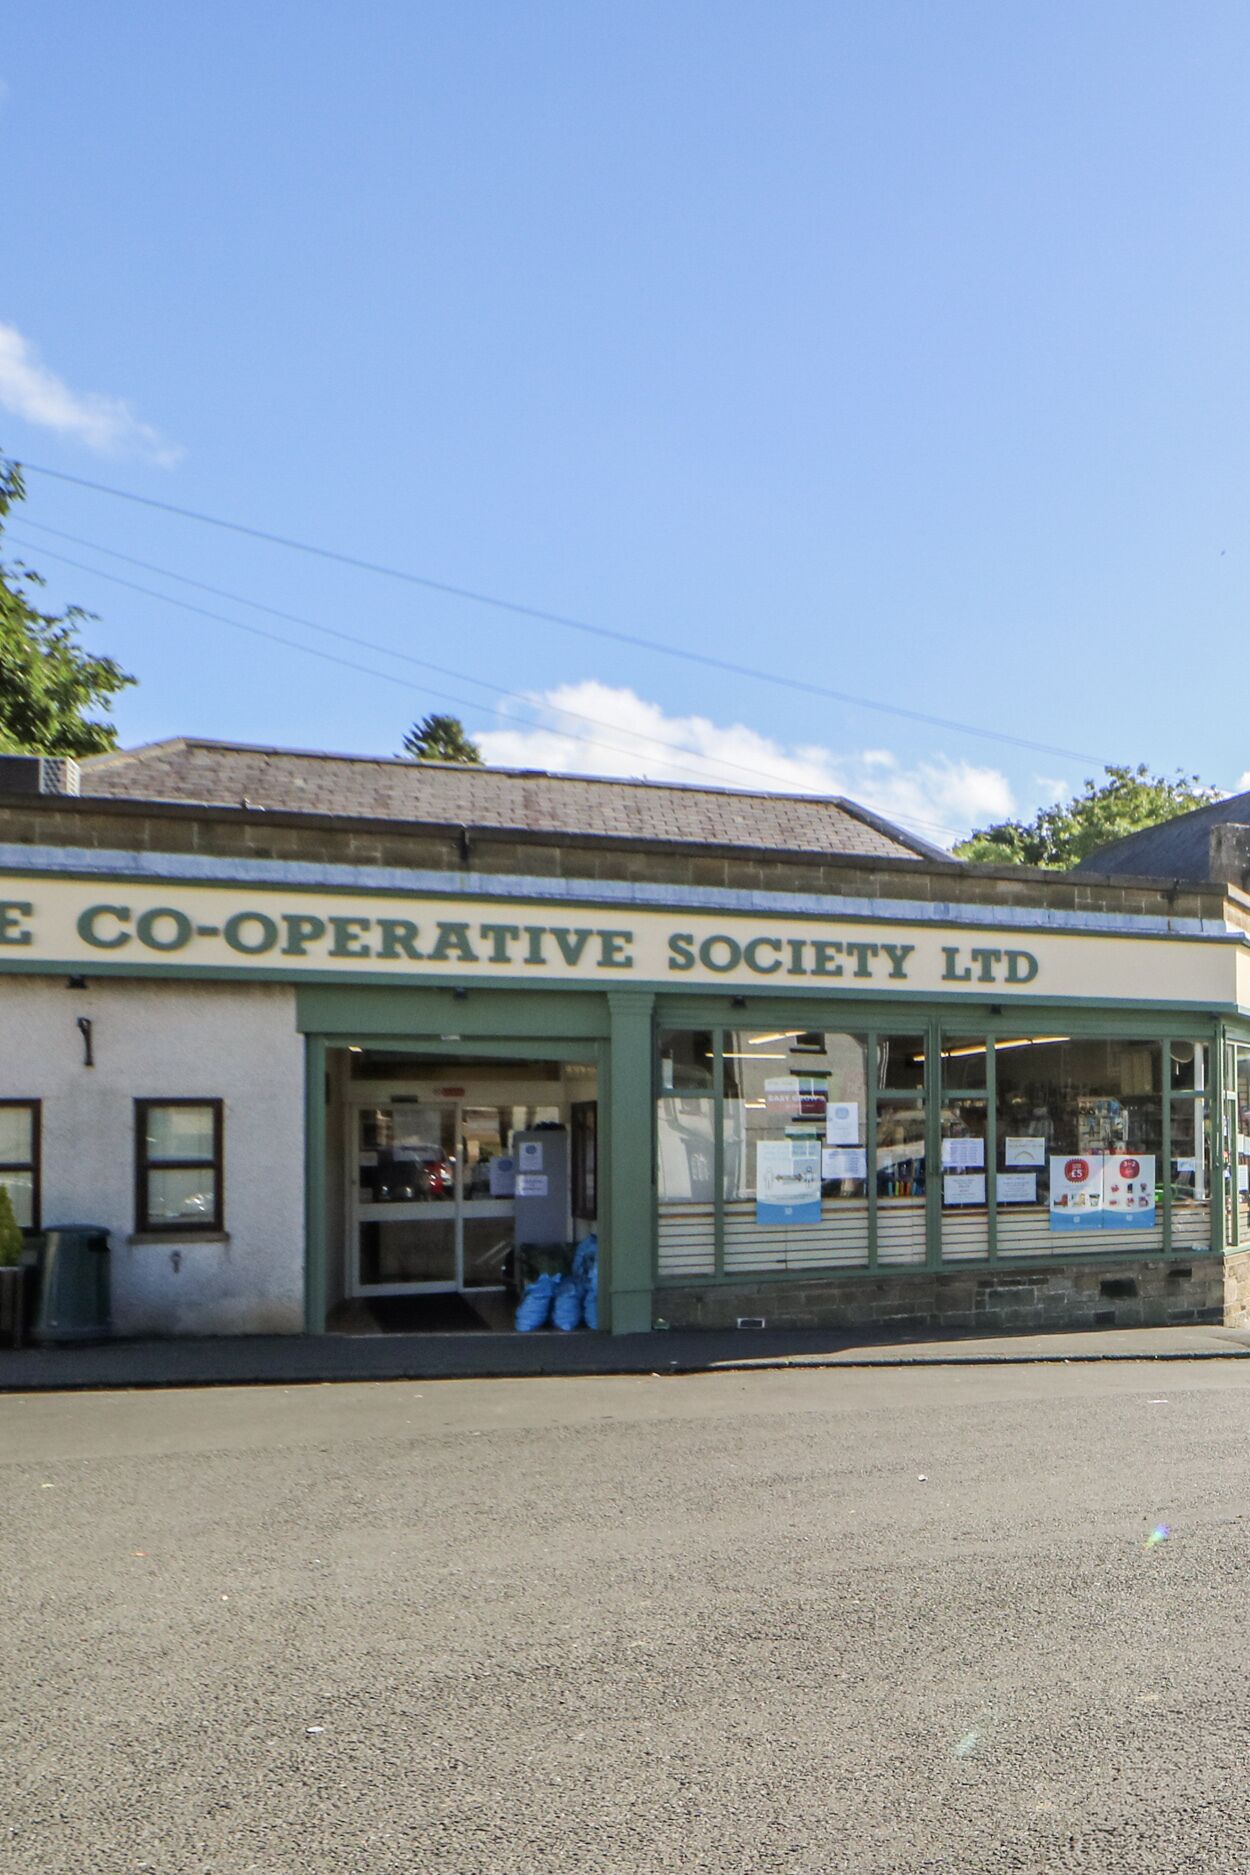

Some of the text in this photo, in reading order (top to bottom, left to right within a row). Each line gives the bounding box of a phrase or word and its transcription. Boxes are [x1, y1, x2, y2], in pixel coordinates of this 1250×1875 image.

[77, 904, 634, 968] CO-OPERATIVE
[668, 933, 915, 978] SOCIETY
[941, 946, 1039, 983] LTD
